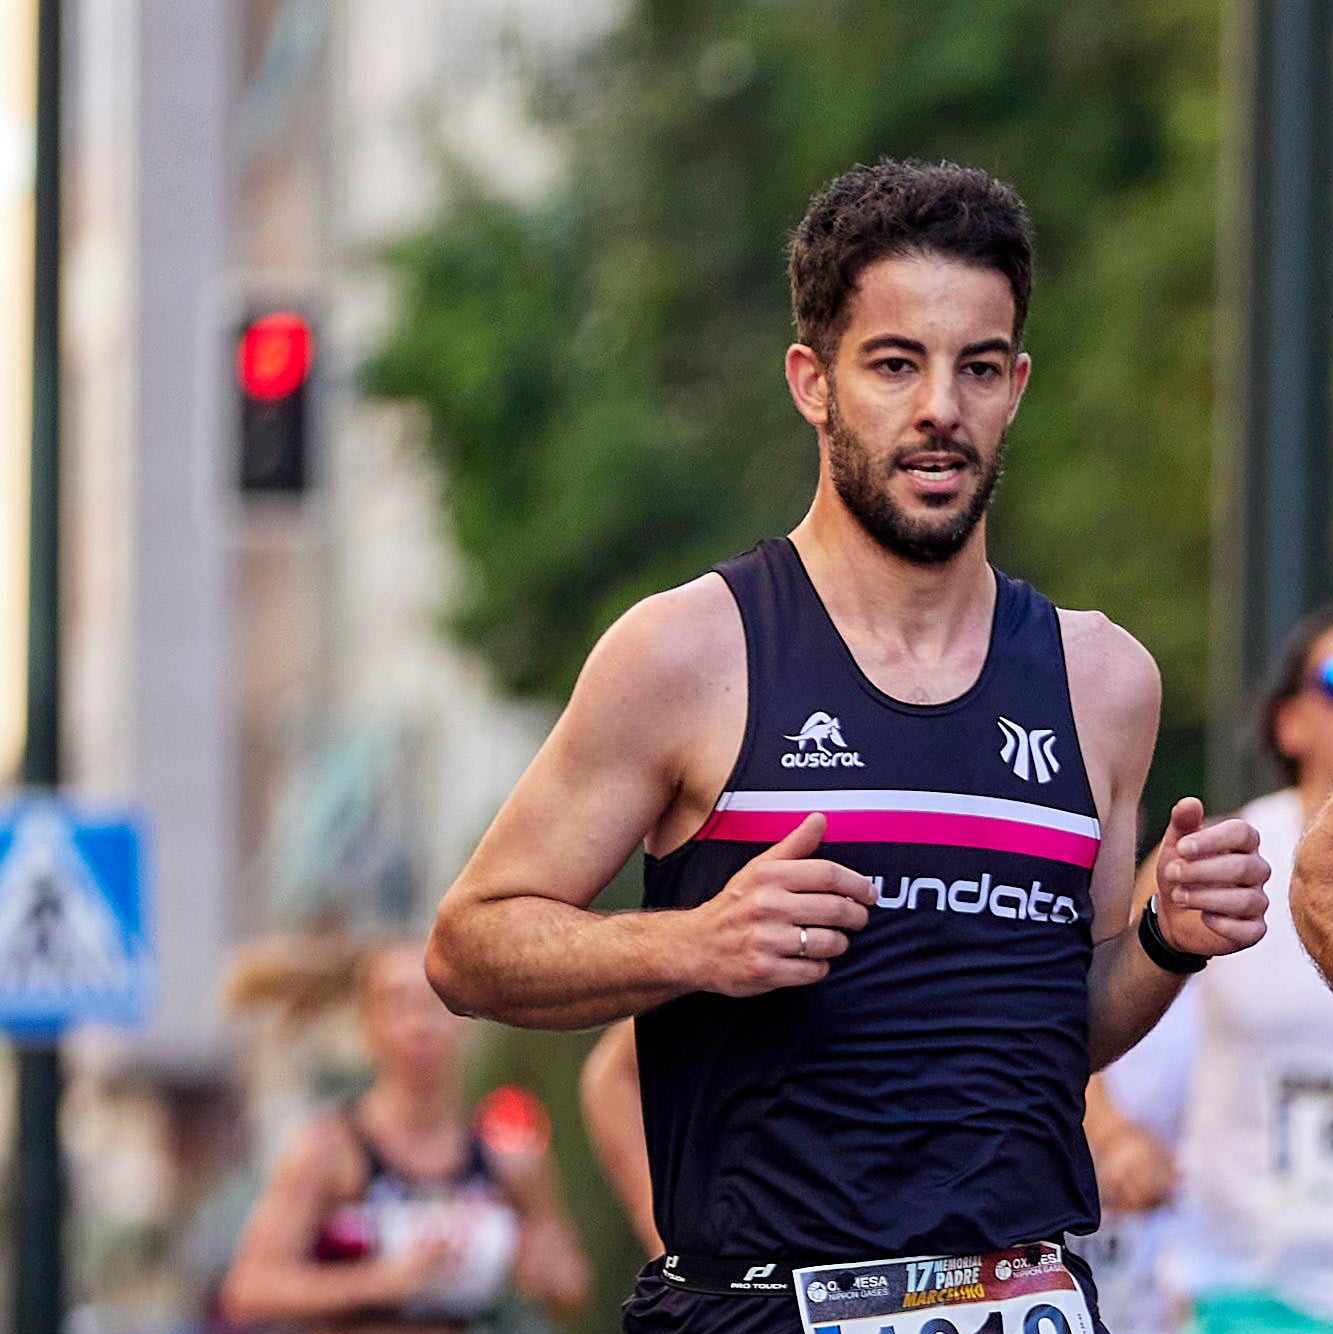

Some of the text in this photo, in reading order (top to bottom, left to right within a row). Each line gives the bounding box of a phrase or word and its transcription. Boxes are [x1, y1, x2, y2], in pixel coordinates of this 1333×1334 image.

[781, 751, 865, 767] austral
[934, 1255, 982, 1273] MEMORIAL
[828, 1275, 888, 1291] OMESA
[906, 1261, 935, 1293] 17
[935, 1268, 981, 1290] PADRE
[828, 1288, 889, 1301] NIPPON GASES
